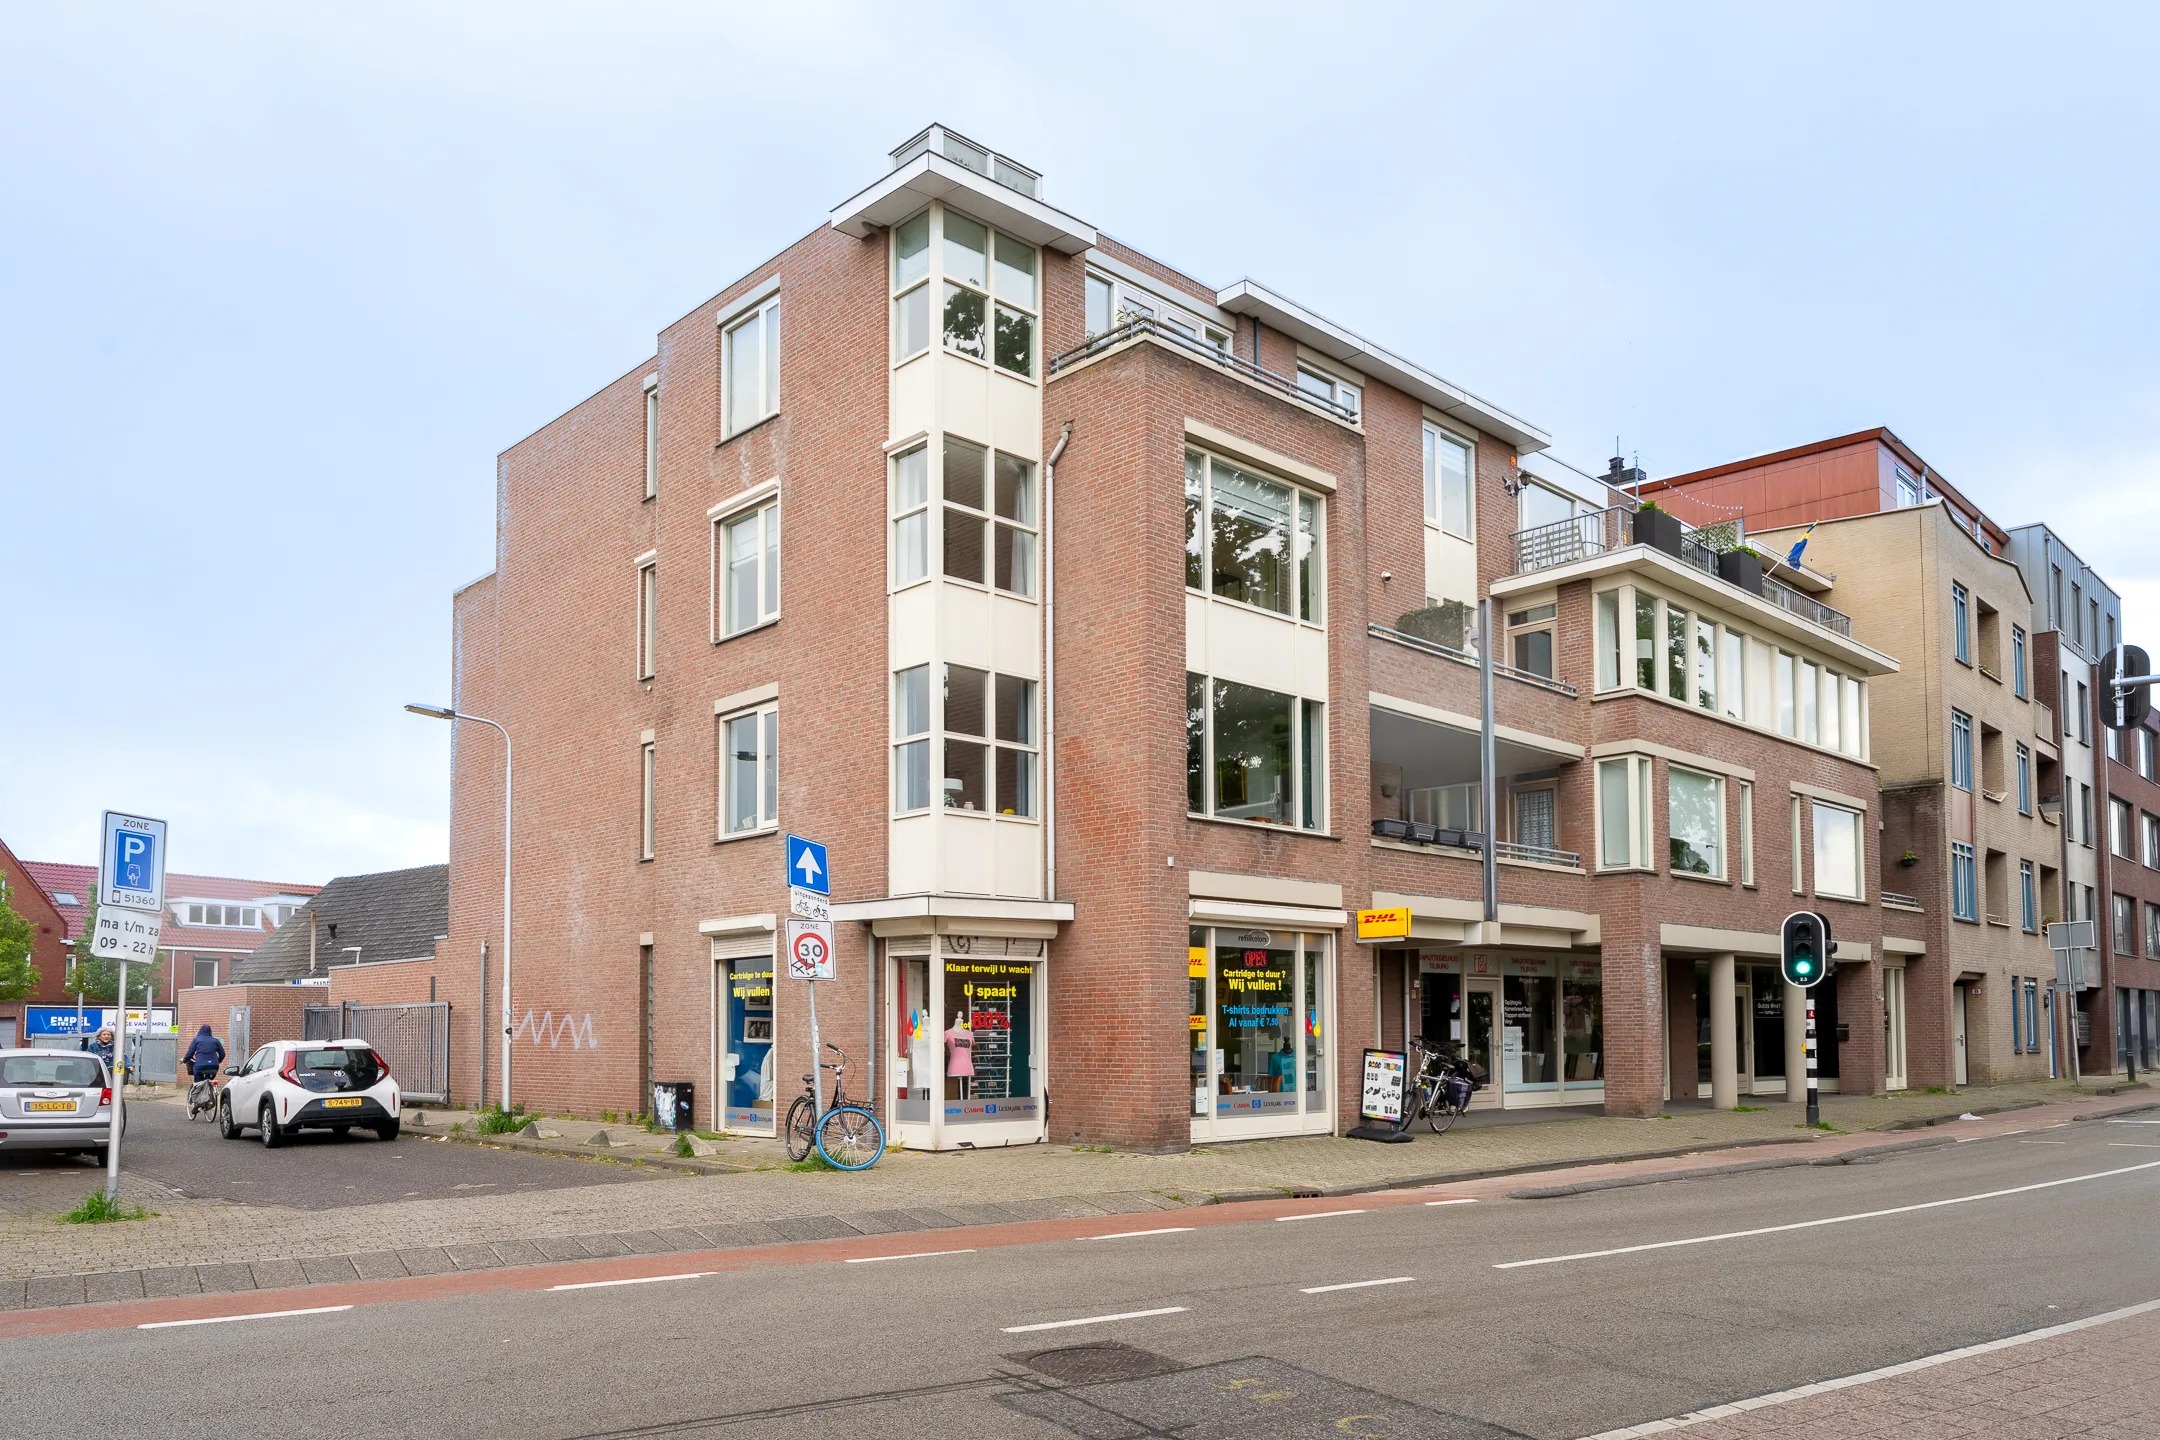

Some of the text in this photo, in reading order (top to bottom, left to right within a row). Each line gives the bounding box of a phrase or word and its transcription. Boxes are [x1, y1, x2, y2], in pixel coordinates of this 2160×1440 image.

[124, 819, 150, 830] ZONE
[124, 837, 145, 862] P
[124, 895, 155, 906] 51360
[794, 890, 828, 904] uitgezonderd
[1364, 914, 1397, 924] DHL
[100, 918, 159, 936] ma t/m za
[1238, 934, 1267, 942] refillcolors
[100, 937, 118, 949] 09
[132, 942, 146, 954] 22
[148, 944, 154, 956] h
[800, 944, 822, 958] 30
[1245, 950, 1266, 967] OPEN
[946, 964, 969, 972] Klaar
[971, 964, 998, 974] terwijl
[1008, 966, 1033, 974] wacht
[1224, 969, 1255, 980] Cartridge
[1257, 970, 1264, 978] te
[1266, 970, 1280, 978] duur
[730, 972, 754, 980] Cartridge
[964, 984, 1016, 1000] U spaart
[1228, 979, 1244, 992] Wij
[1248, 980, 1276, 991] vullen
[733, 987, 745, 1000] Wij
[747, 986, 770, 997] vullen
[1222, 1005, 1288, 1015] T-shirts bedrukken
[972, 1012, 1010, 1030] 80%
[1229, 1018, 1236, 1028] Al
[1238, 1018, 1258, 1028] vanaf
[1260, 1018, 1264, 1028] €
